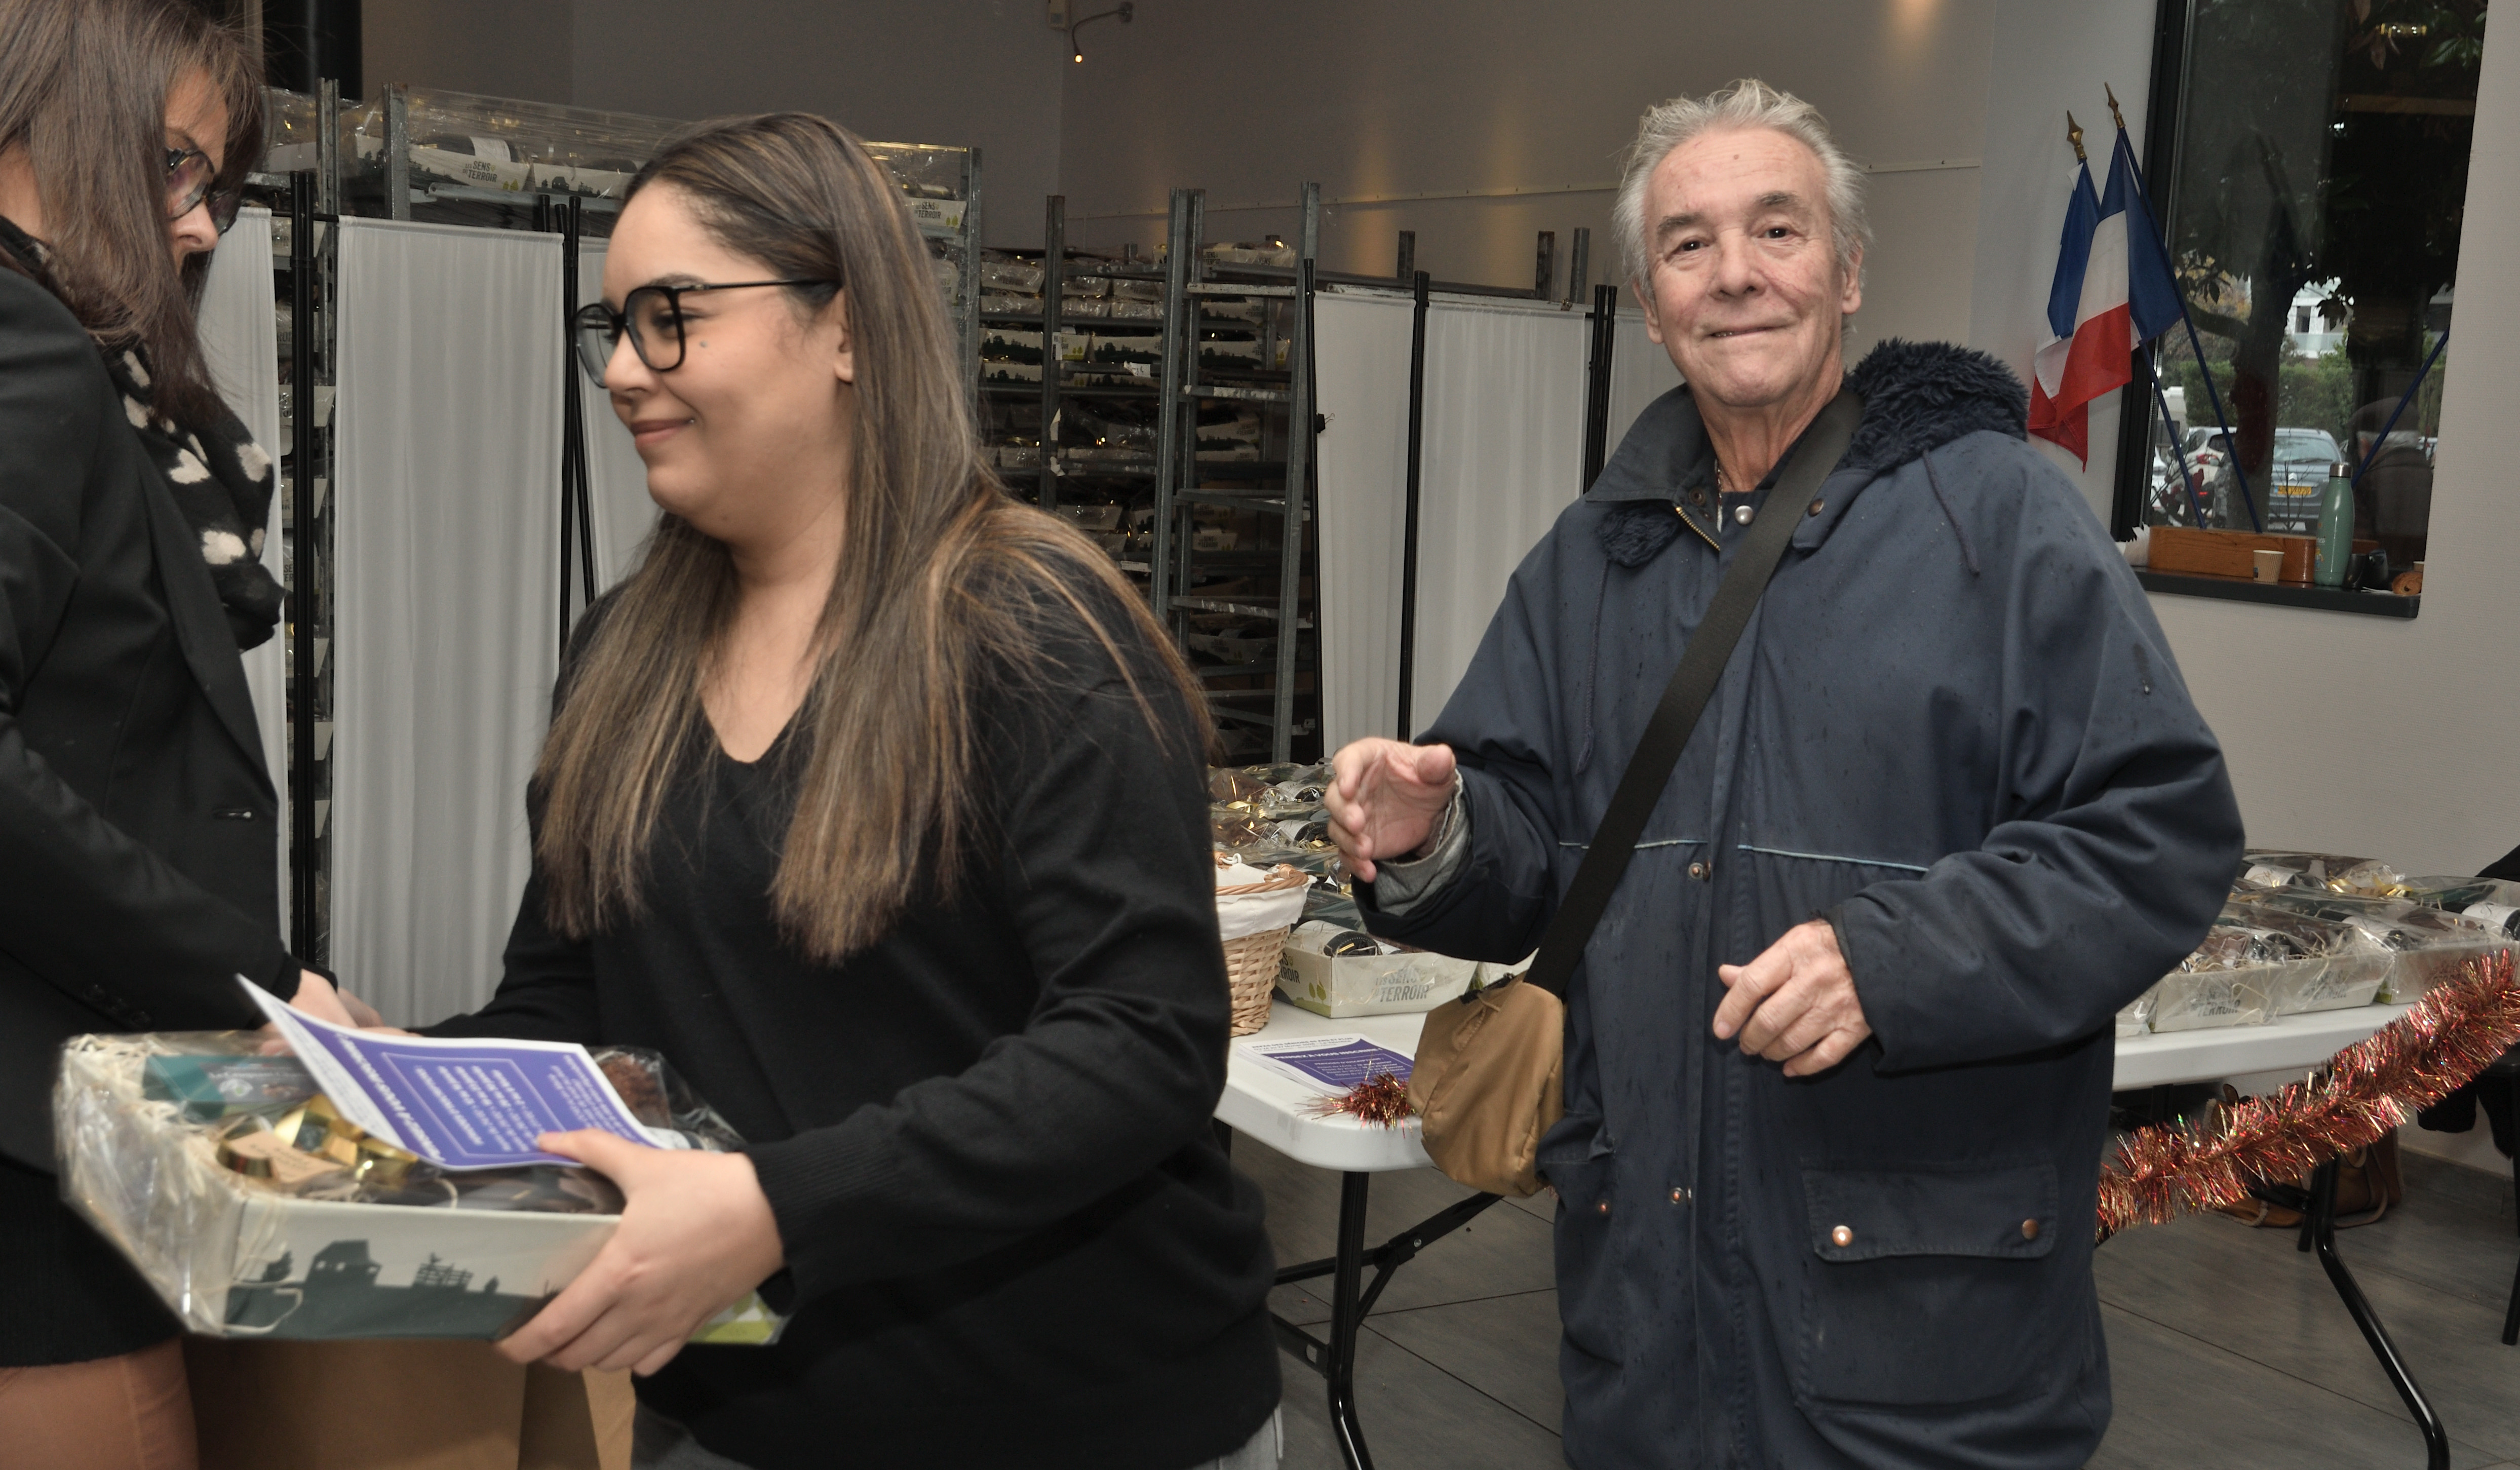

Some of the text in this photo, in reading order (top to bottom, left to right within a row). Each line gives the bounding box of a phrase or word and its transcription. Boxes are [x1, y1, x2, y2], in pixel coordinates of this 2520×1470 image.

[473, 161, 491, 172] SENS
[468, 169, 497, 182] TERROIR
[921, 202, 935, 210] SENS
[918, 210, 941, 219] TERROIR
[1380, 985, 1429, 1002] TERROIR
